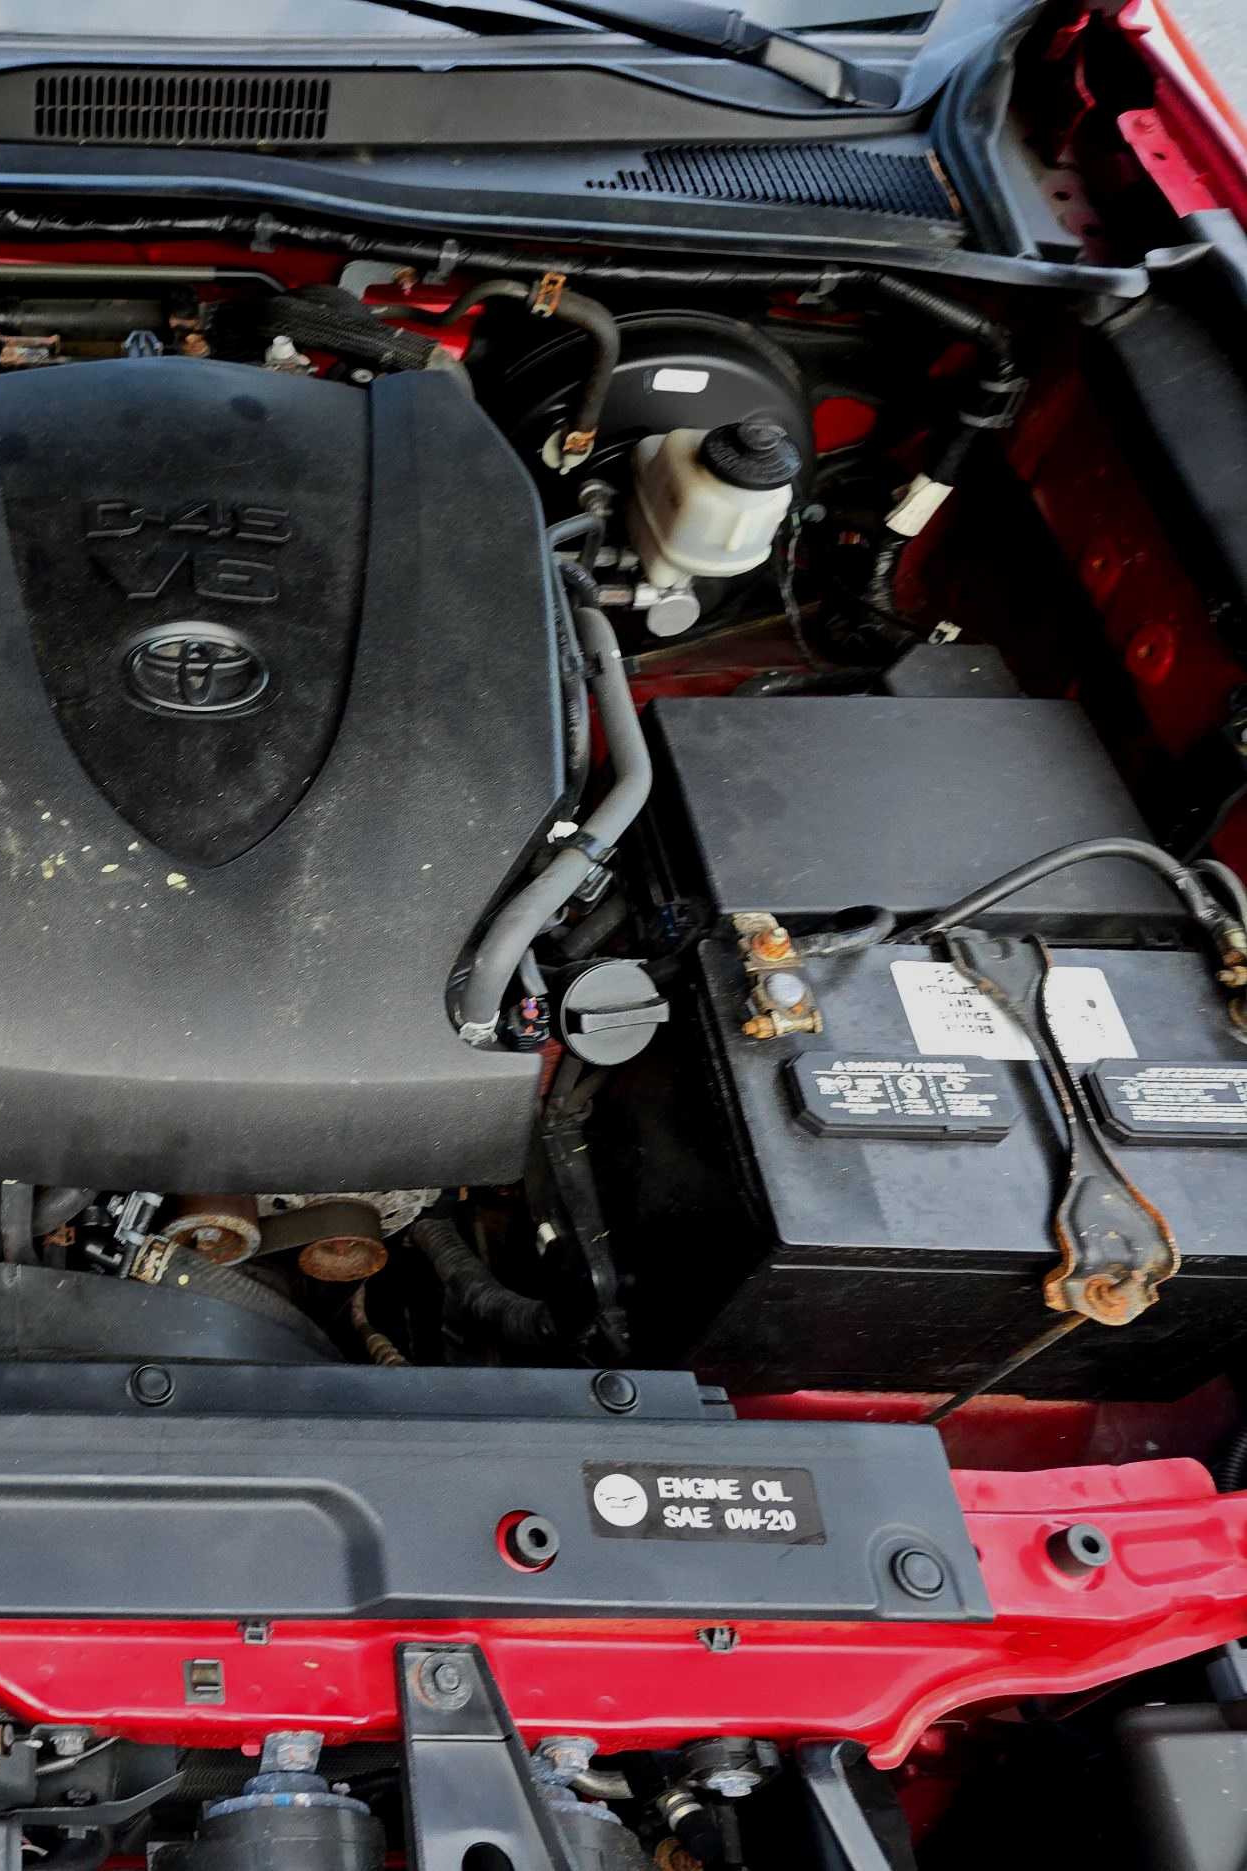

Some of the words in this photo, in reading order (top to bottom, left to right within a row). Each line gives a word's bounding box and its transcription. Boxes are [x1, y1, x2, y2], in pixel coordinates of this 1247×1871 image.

[85, 501, 294, 544] D-4S
[90, 550, 280, 601] V6
[657, 1477, 742, 1500] ENGINE
[752, 1480, 793, 1501] OIL
[663, 1506, 712, 1528] SAE
[724, 1508, 796, 1531] 0W-20
